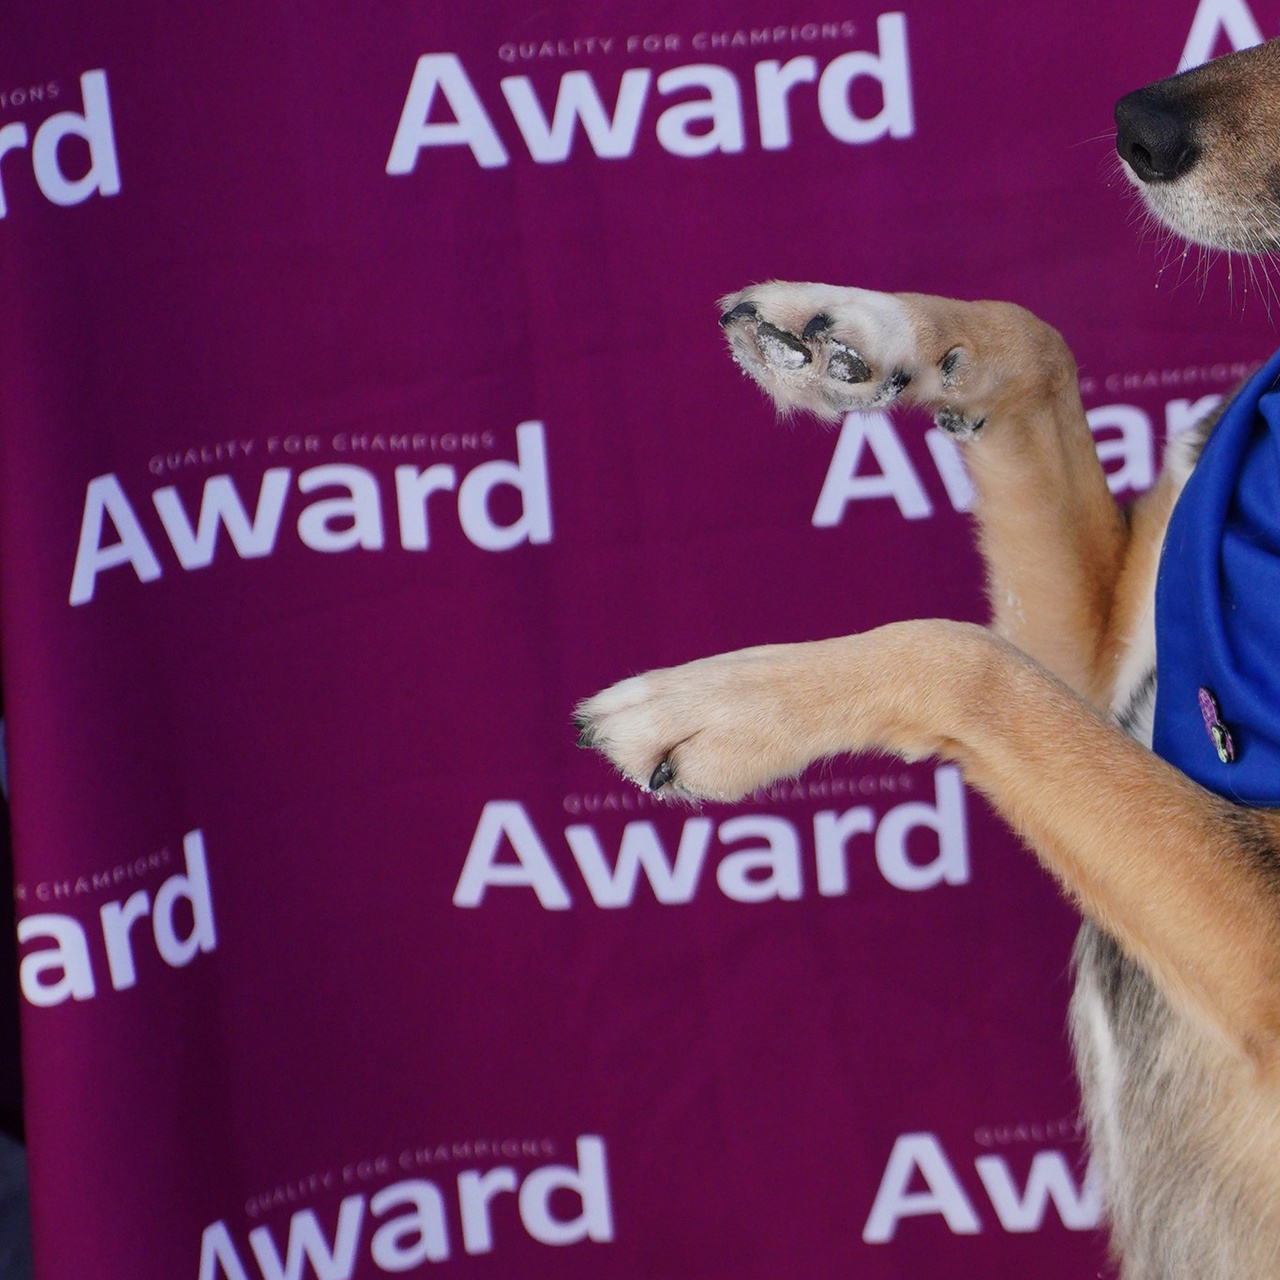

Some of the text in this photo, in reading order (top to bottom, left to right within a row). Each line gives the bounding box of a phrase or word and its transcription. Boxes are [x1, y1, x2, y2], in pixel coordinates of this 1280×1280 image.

[386, 13, 914, 176] Award
[498, 20, 858, 63] QUALITY FOR CHAMPIONS
[68, 420, 554, 607] Award
[148, 428, 496, 476] QUALITY FOR CHAMPIONS
[452, 766, 972, 911] Award
